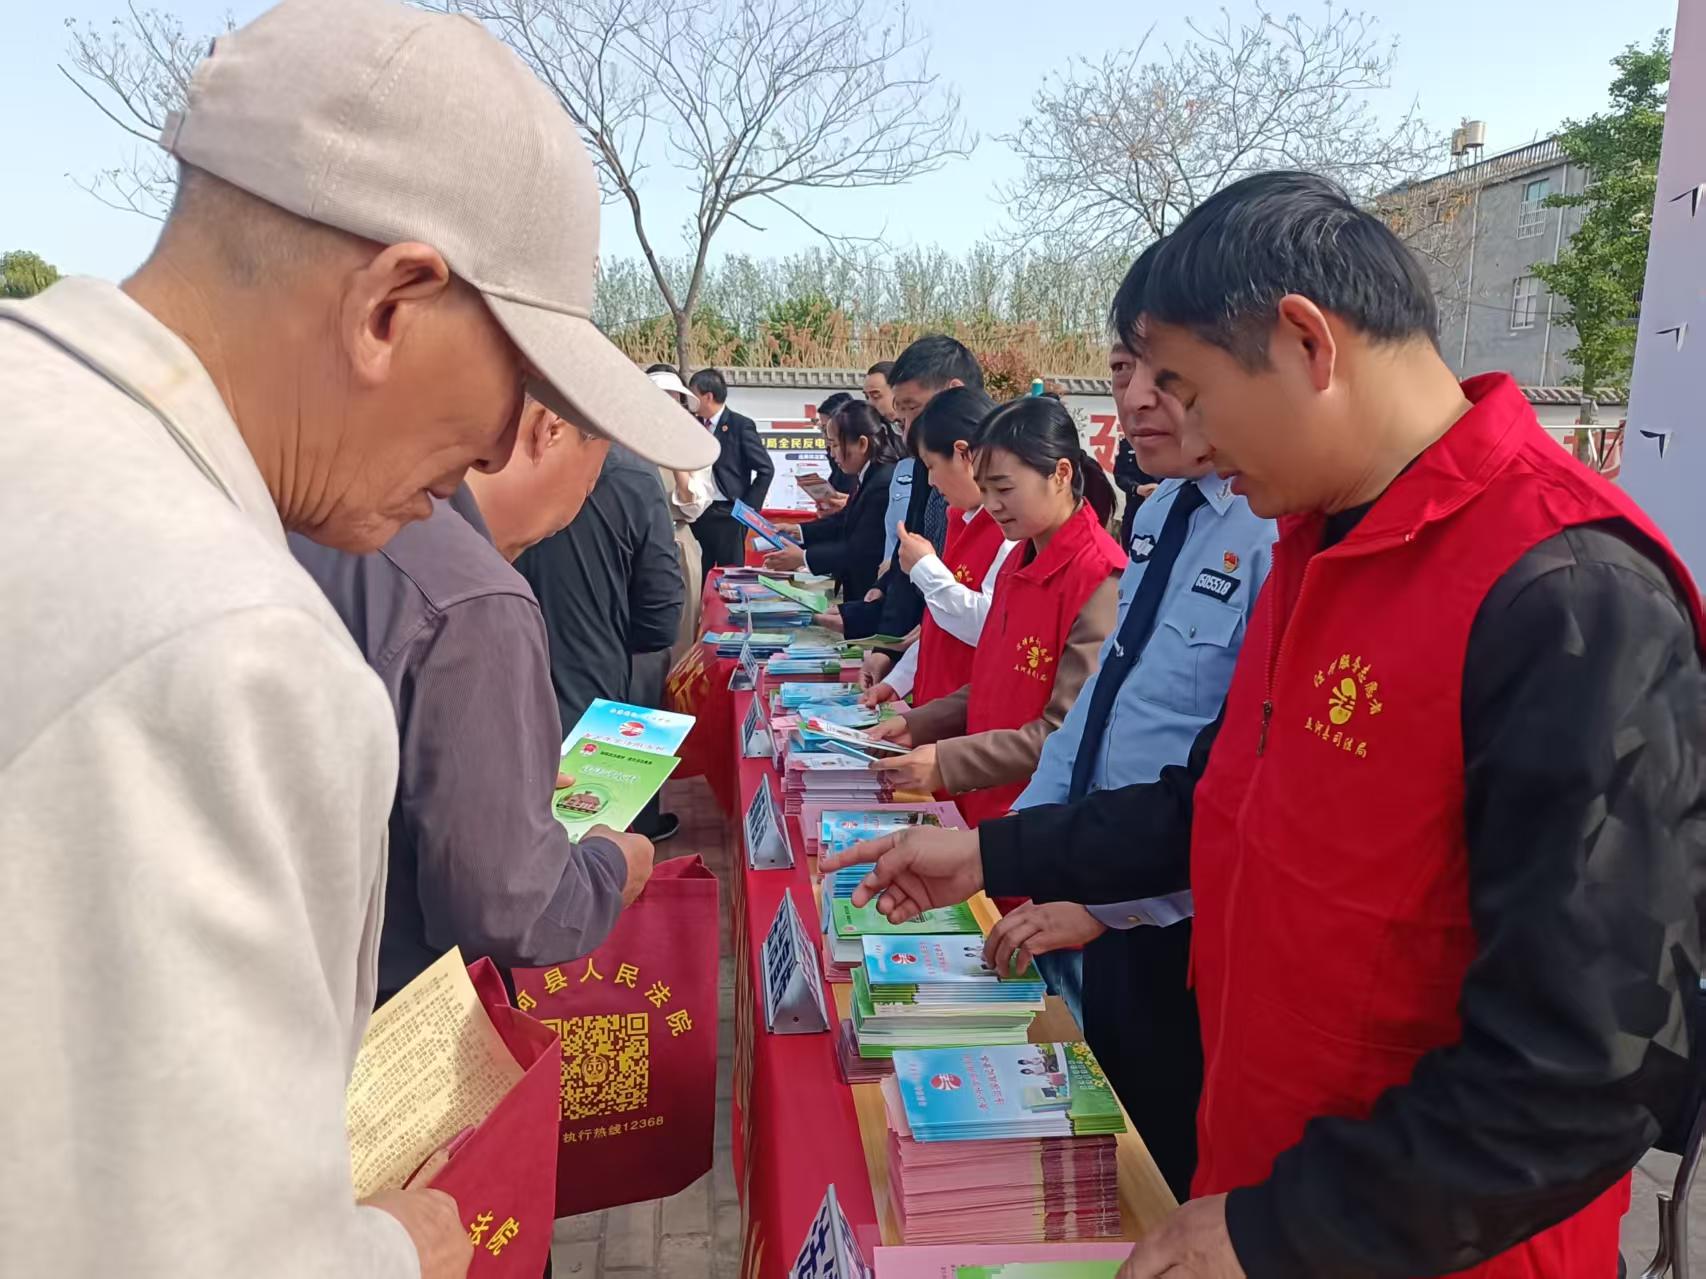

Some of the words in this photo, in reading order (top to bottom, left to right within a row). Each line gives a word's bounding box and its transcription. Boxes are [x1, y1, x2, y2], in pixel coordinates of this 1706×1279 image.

[761, 437, 827, 450] 局全民反电
[563, 1115, 664, 1143] 执行热线12368
